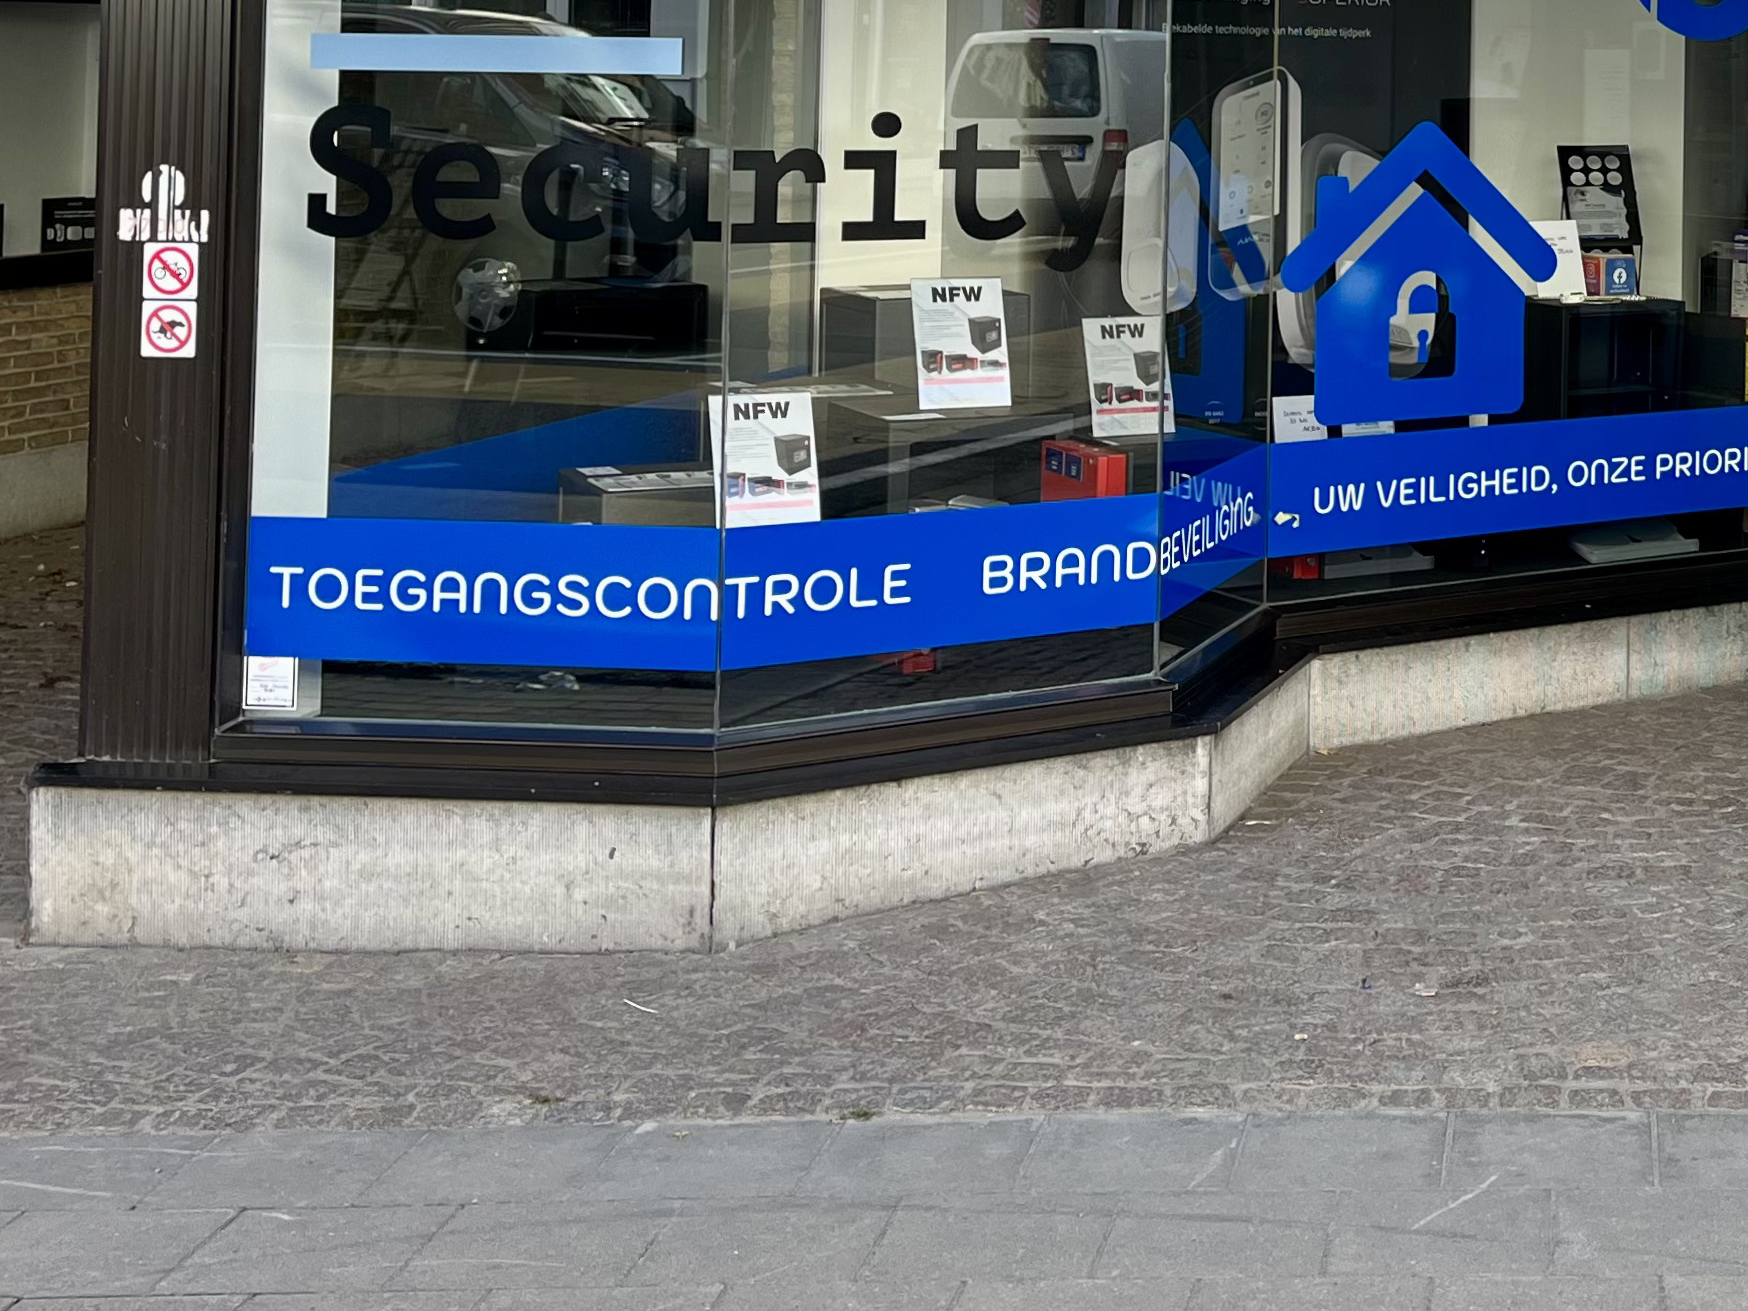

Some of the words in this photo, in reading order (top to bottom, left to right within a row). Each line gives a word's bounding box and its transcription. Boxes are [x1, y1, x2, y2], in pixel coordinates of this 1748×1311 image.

[1304, 25, 1338, 38] digitale
[306, 102, 1126, 273] Security
[1312, 482, 1366, 516] UW
[1377, 464, 1558, 510] VEILIGHEID,
[1567, 456, 1647, 486] ONZE
[981, 489, 1255, 594] BRANDBEVEILIGING
[269, 562, 912, 621] TOEGANGSCONTROLE
